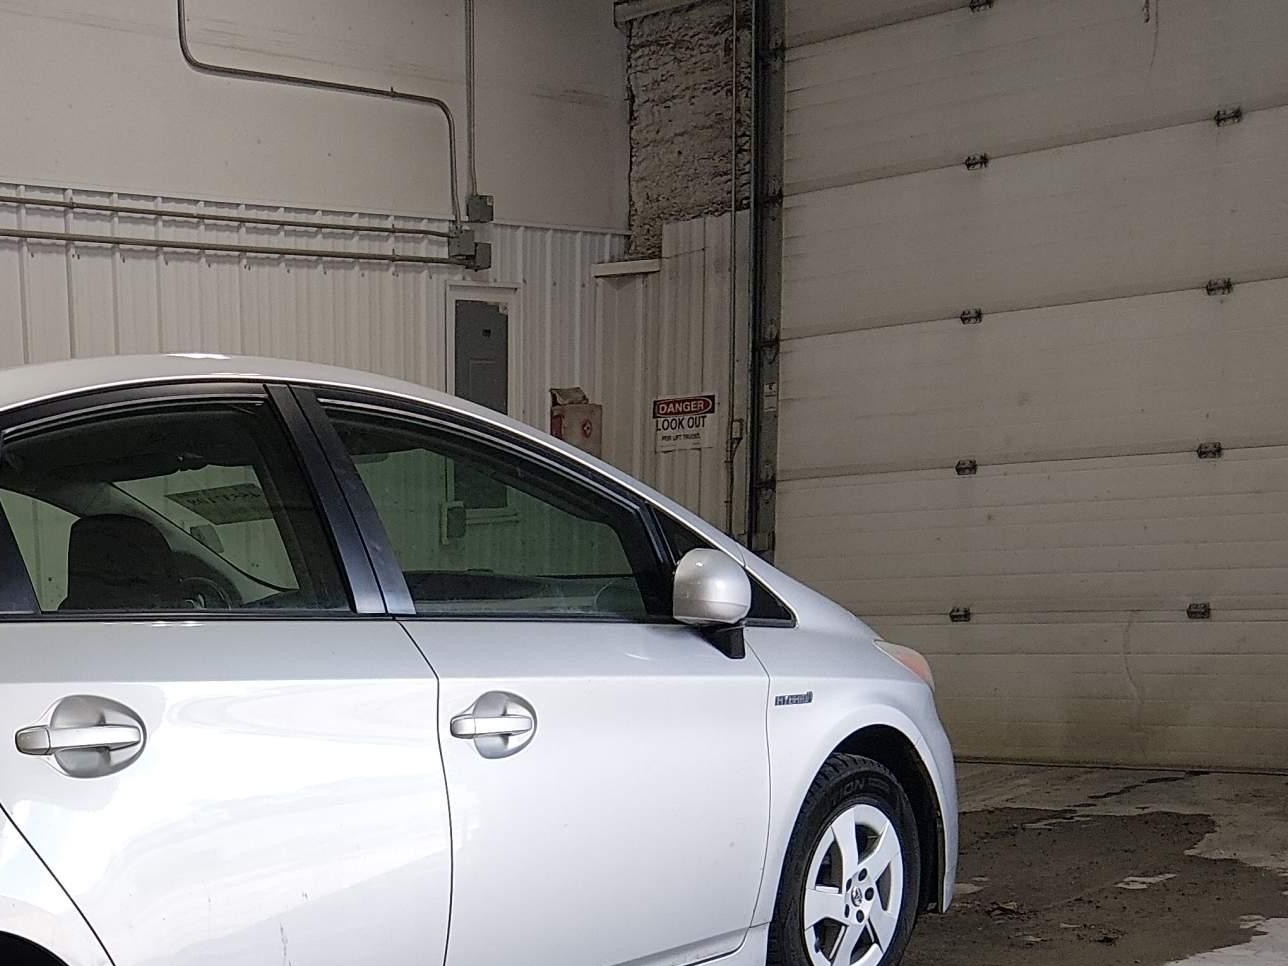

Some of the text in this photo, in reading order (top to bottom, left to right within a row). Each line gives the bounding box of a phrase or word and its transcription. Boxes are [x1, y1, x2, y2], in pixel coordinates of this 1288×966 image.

[659, 400, 705, 414] DANGER
[656, 415, 707, 432] LOOK OUT
